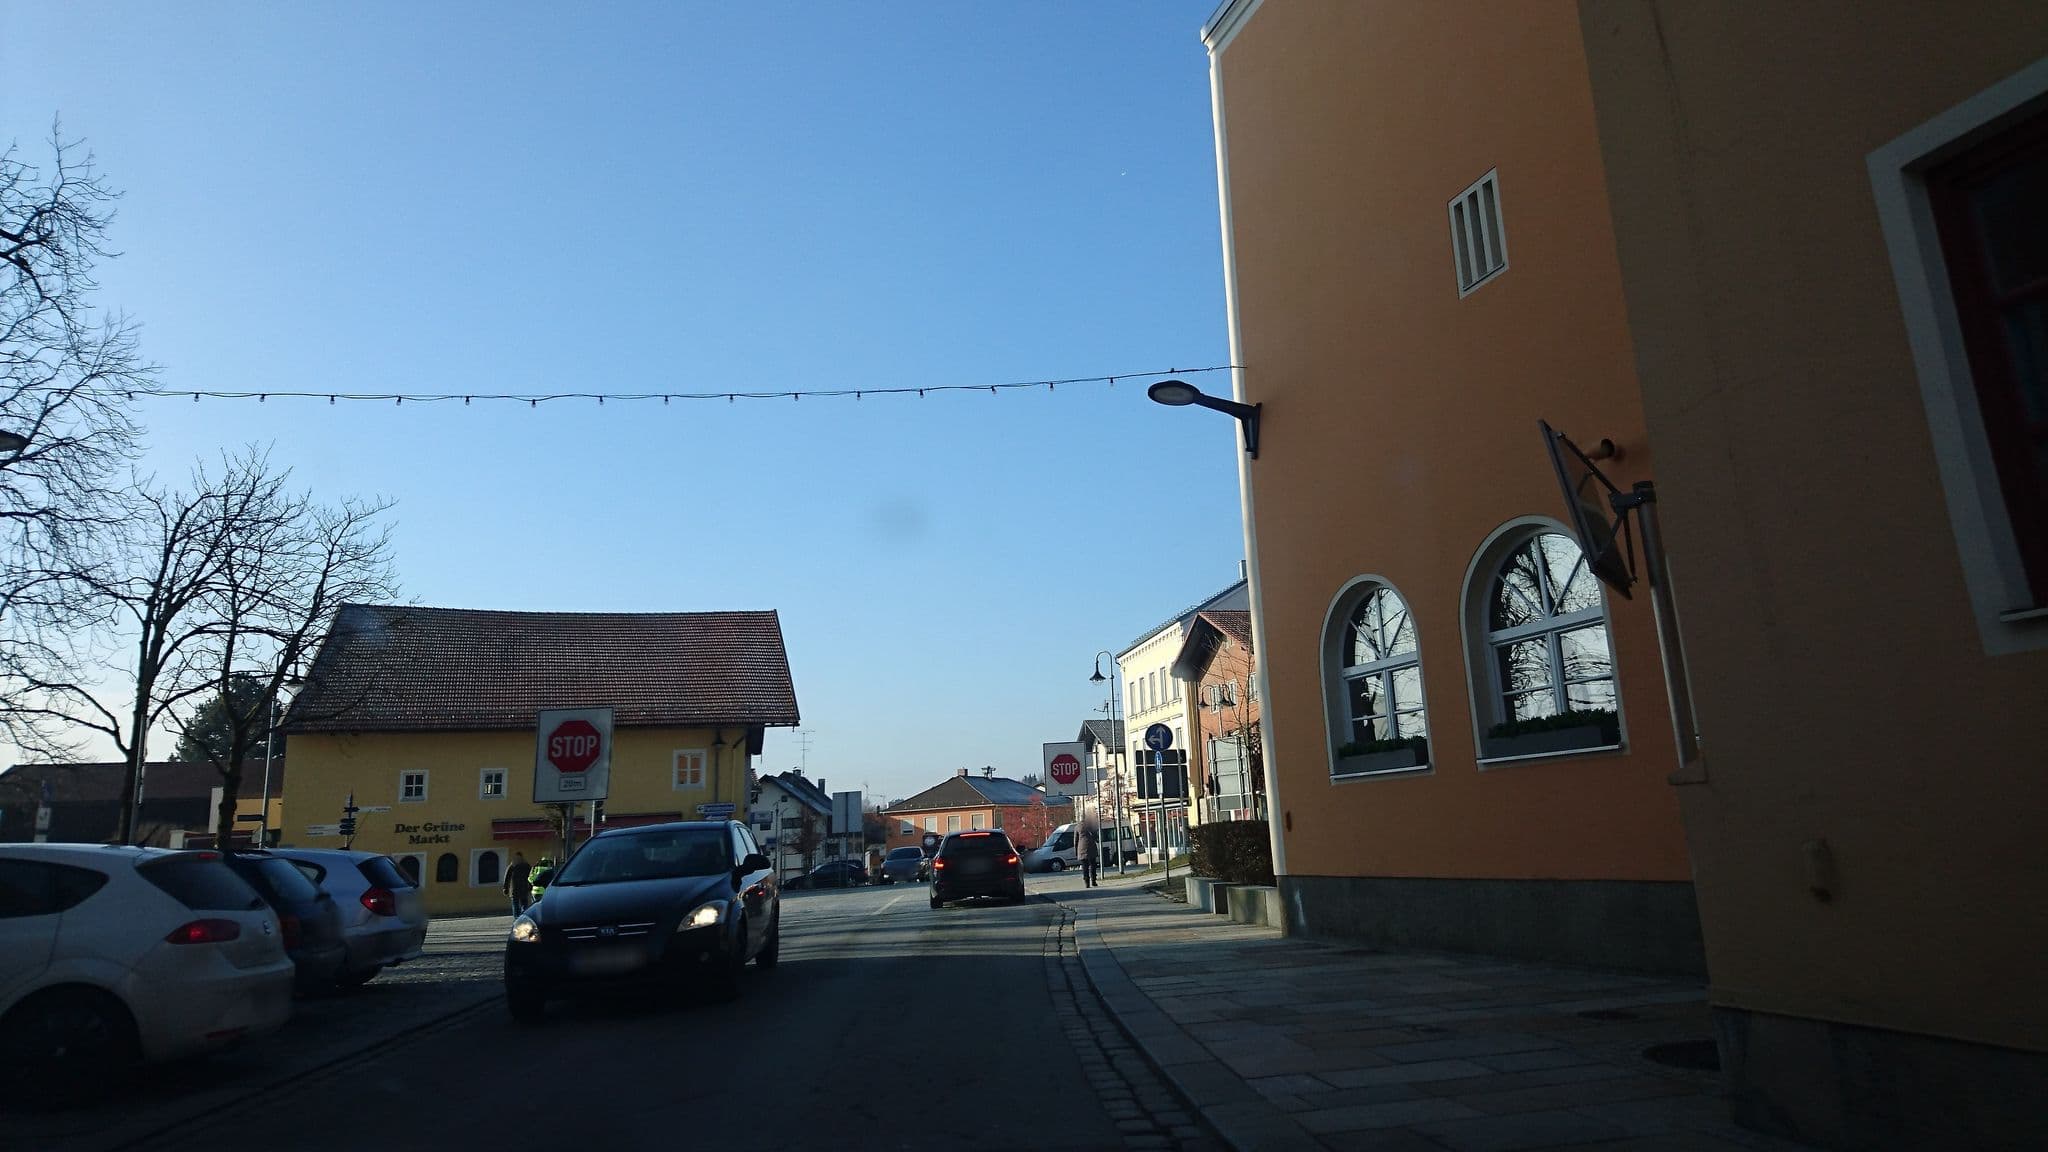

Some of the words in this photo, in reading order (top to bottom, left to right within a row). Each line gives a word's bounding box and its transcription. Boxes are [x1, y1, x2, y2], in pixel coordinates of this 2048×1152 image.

[551, 736, 597, 758] STOP
[1053, 763, 1079, 776] STOP
[395, 823, 420, 834] Der
[423, 821, 465, 832] Grüne
[409, 834, 450, 844] Markt
